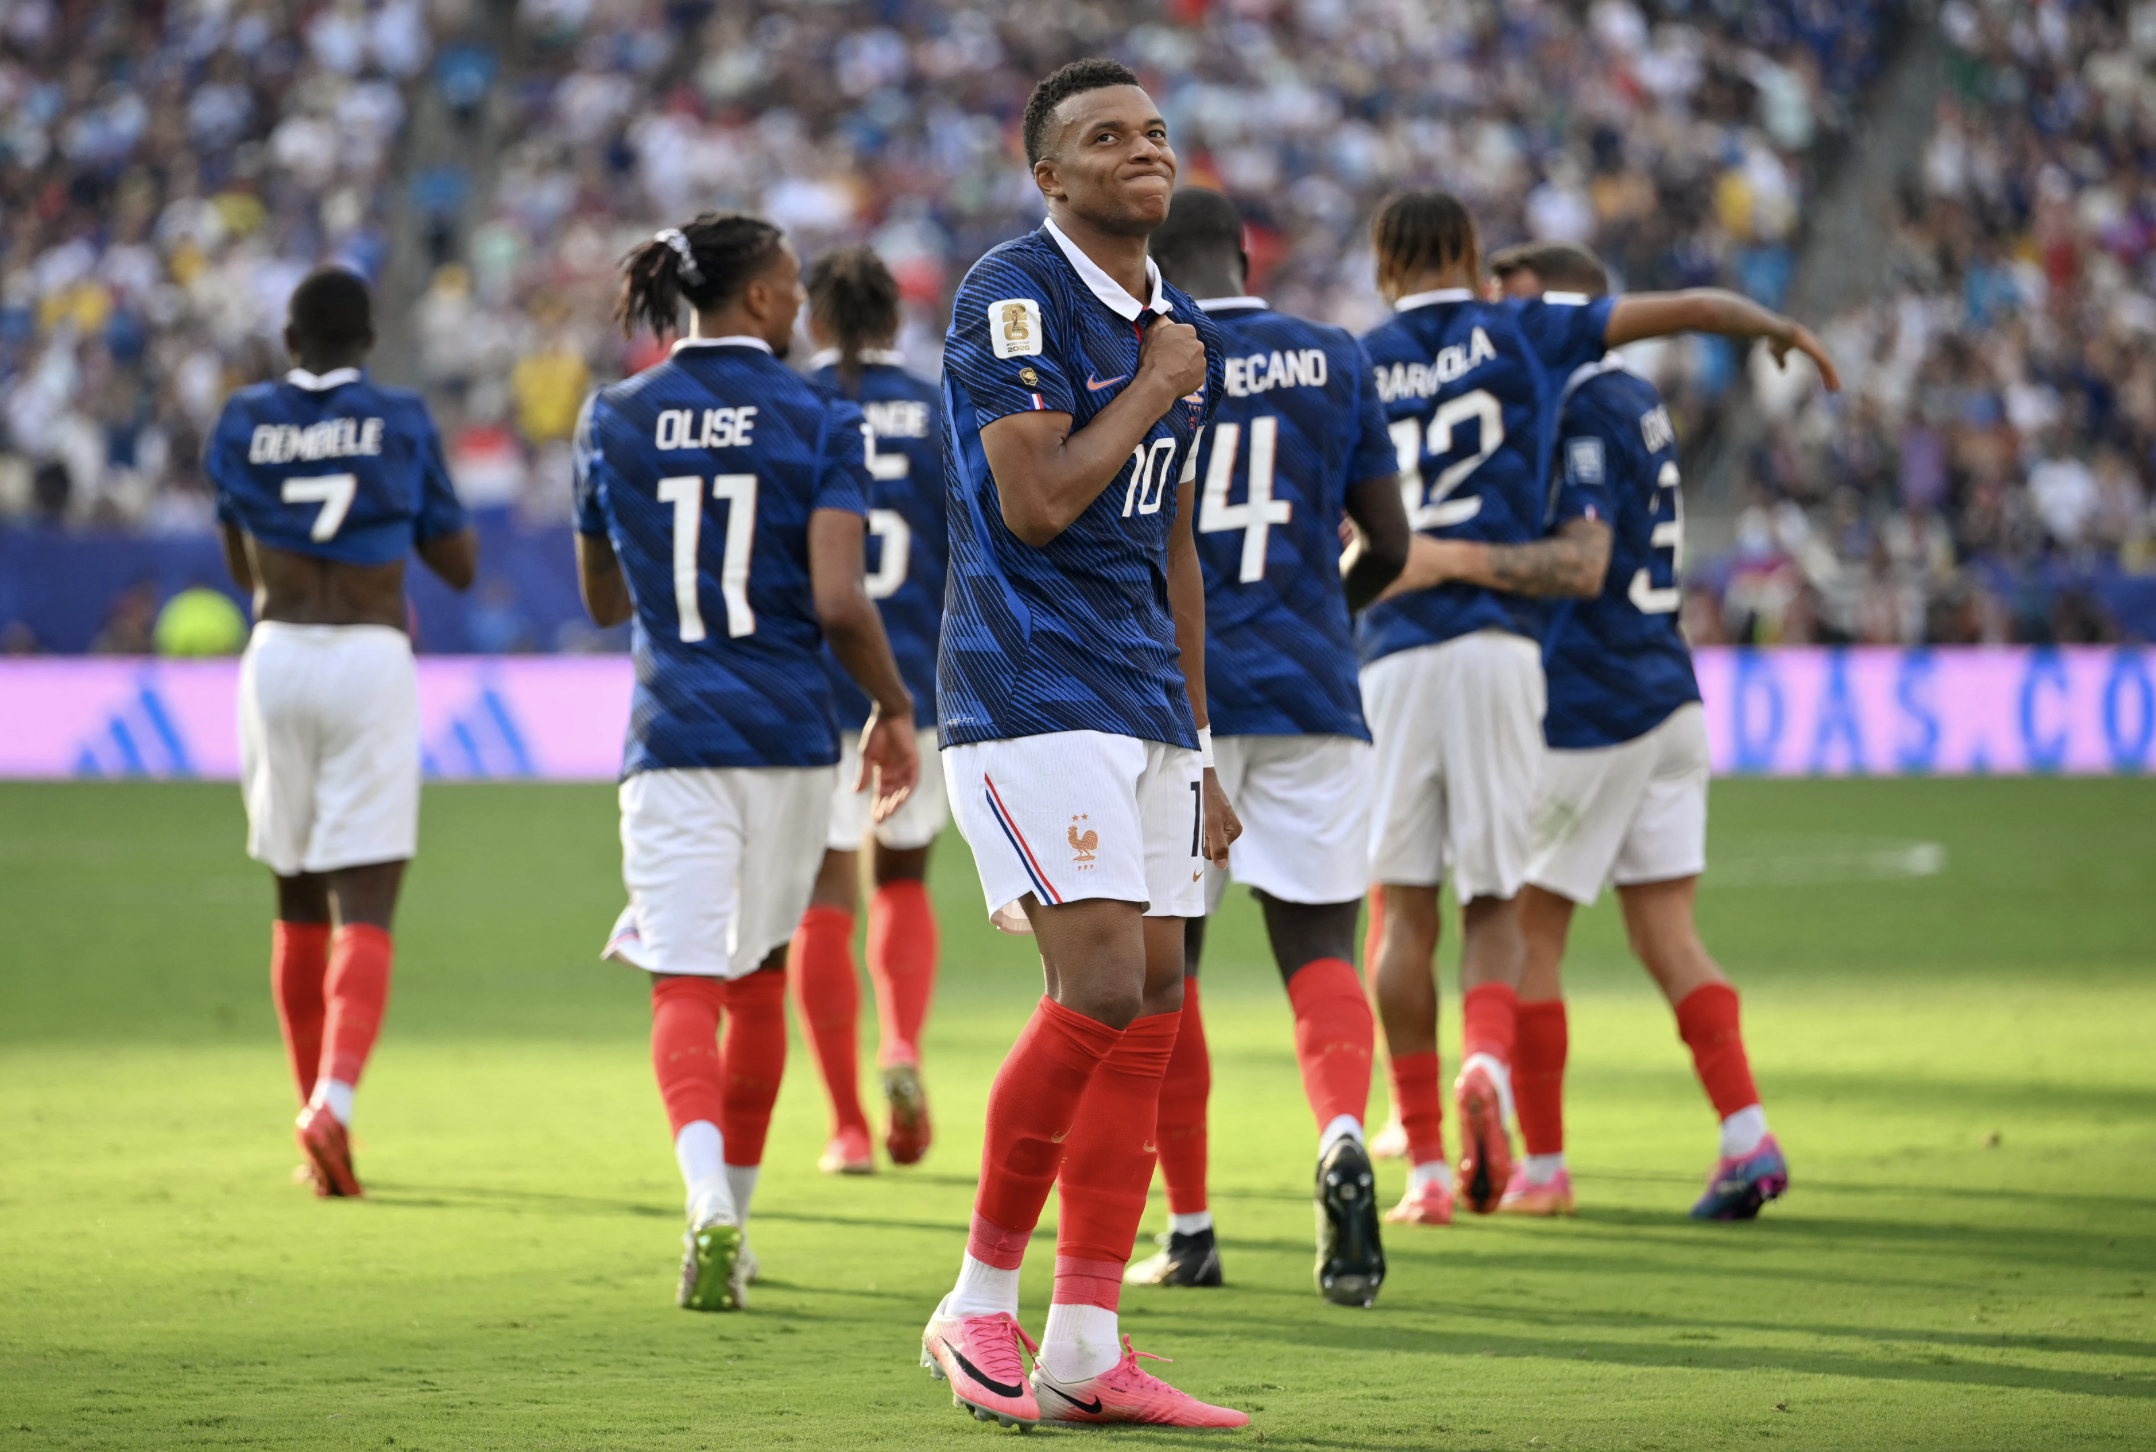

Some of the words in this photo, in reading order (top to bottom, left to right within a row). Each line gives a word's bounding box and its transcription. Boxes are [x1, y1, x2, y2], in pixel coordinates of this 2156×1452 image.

[249, 417, 385, 465] DEMBELE
[655, 406, 758, 450] OLISE
[1388, 388, 1504, 531] 12
[280, 473, 358, 544] 7
[1122, 437, 1176, 517] 10
[1199, 416, 1293, 583] 4
[657, 474, 759, 643] 11
